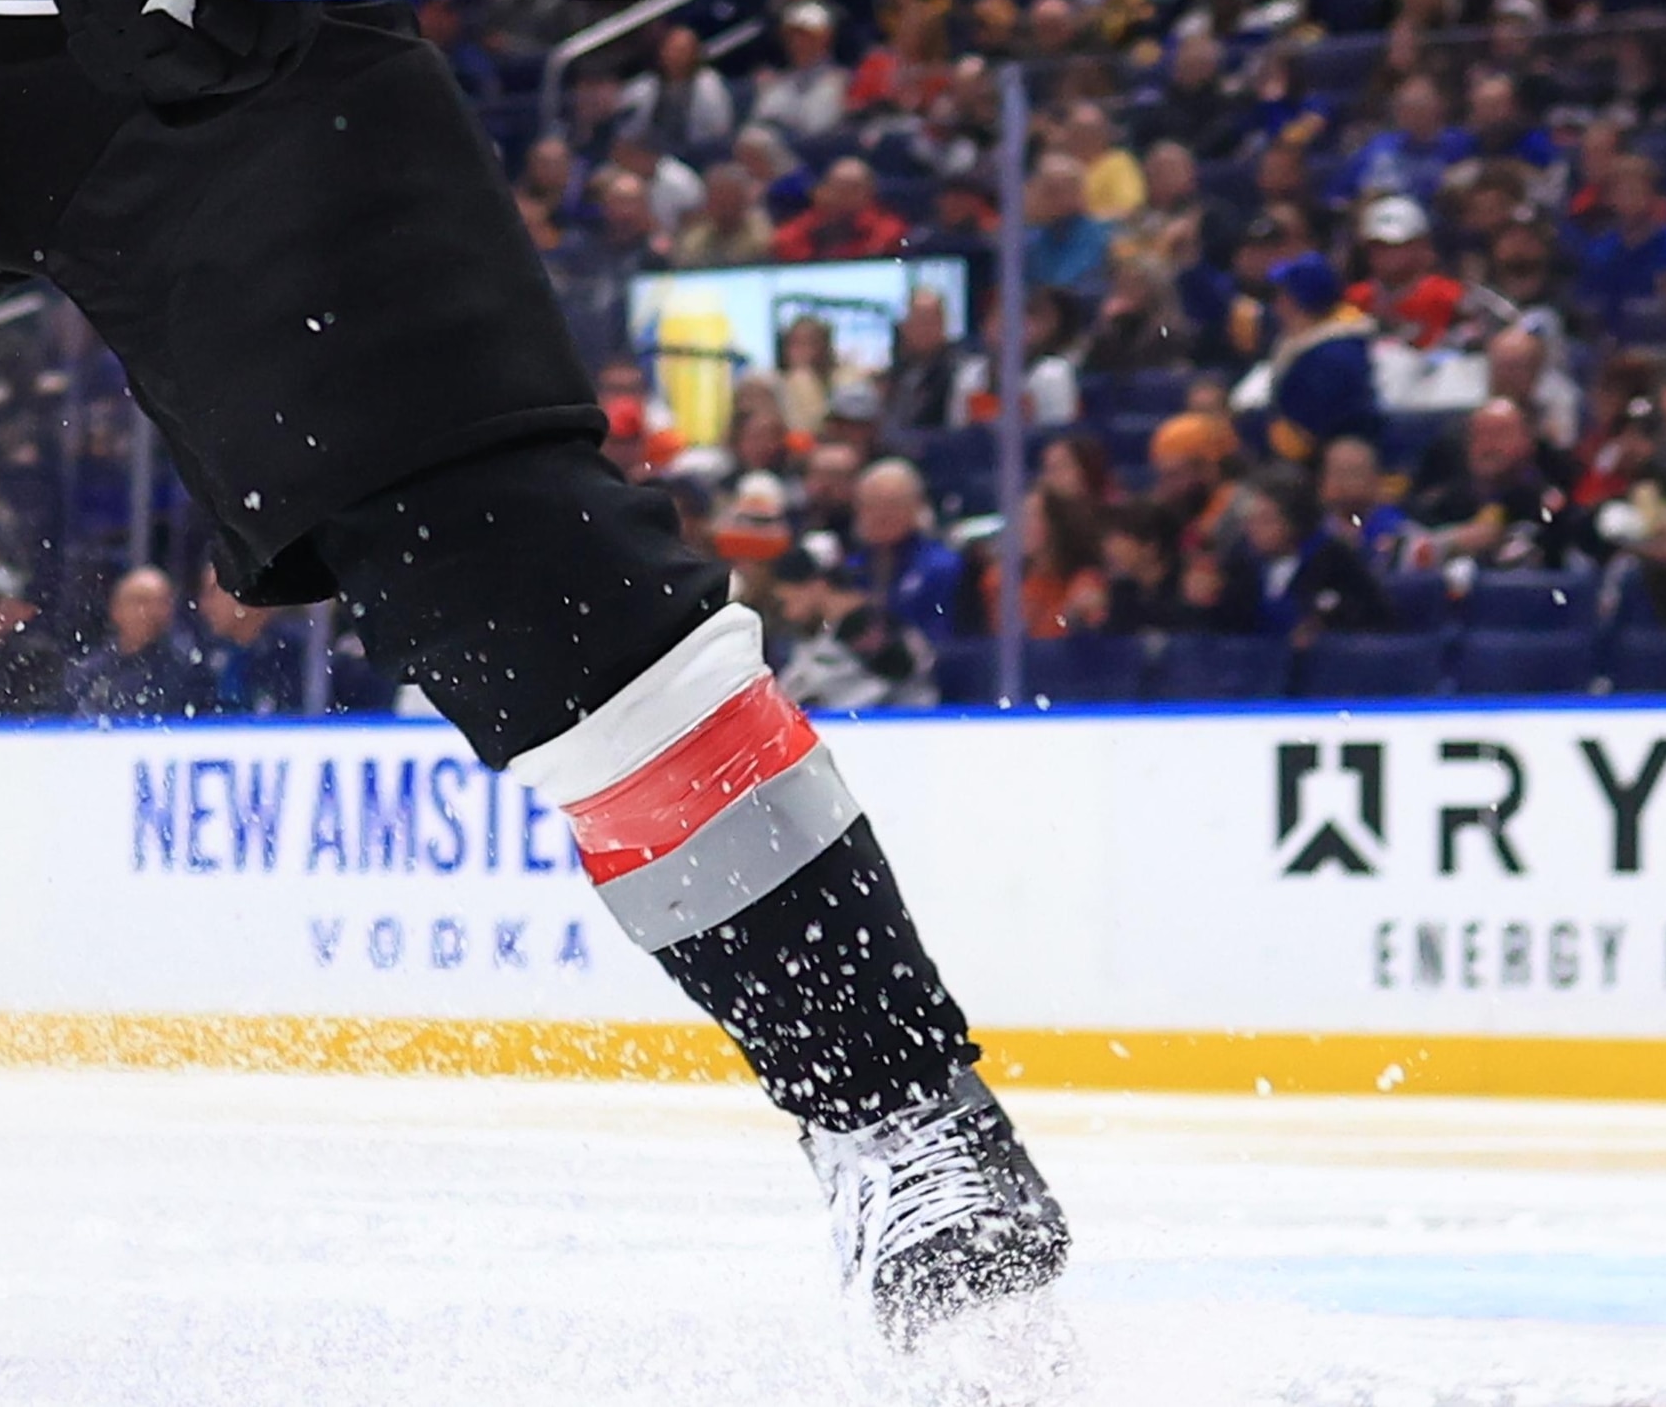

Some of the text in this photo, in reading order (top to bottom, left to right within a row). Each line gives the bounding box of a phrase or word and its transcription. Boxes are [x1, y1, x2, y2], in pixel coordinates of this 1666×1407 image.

[133, 758, 583, 874] NEW AMSTE
[308, 915, 591, 971] VODKA
[1372, 919, 1627, 989] ENERGY
